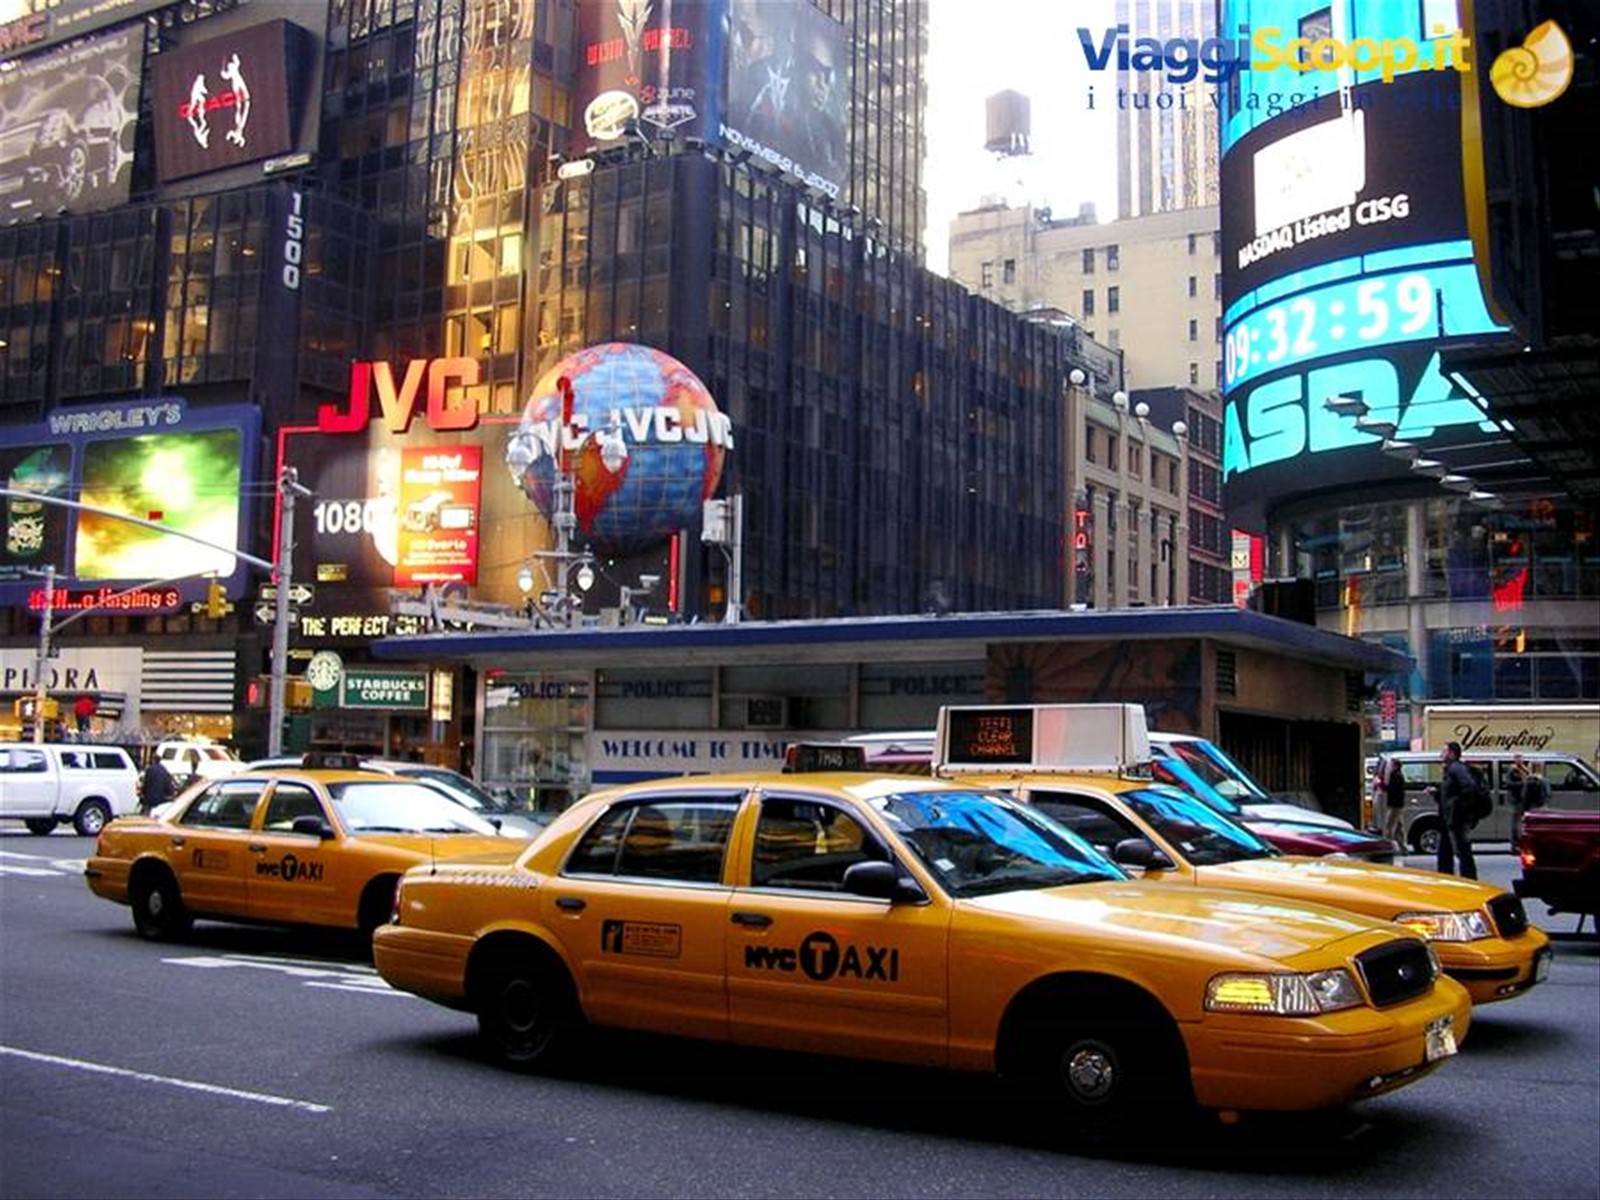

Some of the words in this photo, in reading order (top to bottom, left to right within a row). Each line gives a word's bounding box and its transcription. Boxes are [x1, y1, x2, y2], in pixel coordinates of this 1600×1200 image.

[283, 191, 303, 290] 1500
[1238, 227, 1294, 270] NASDAQ
[1295, 206, 1350, 243] Listed
[318, 357, 480, 433] JVC
[49, 403, 181, 435] WRIGLEY'S
[302, 616, 326, 636] THE
[331, 615, 390, 636] PERFECT
[347, 678, 425, 692] STARBUCKS
[361, 690, 411, 701] COFFEE
[622, 681, 687, 698] POLICE
[889, 673, 969, 697] POLICE
[602, 740, 697, 758] WELCOME
[710, 740, 727, 758] TO
[1454, 723, 1555, 751] Yuengling
[745, 945, 797, 972] NYC
[801, 931, 899, 982] TAXI
